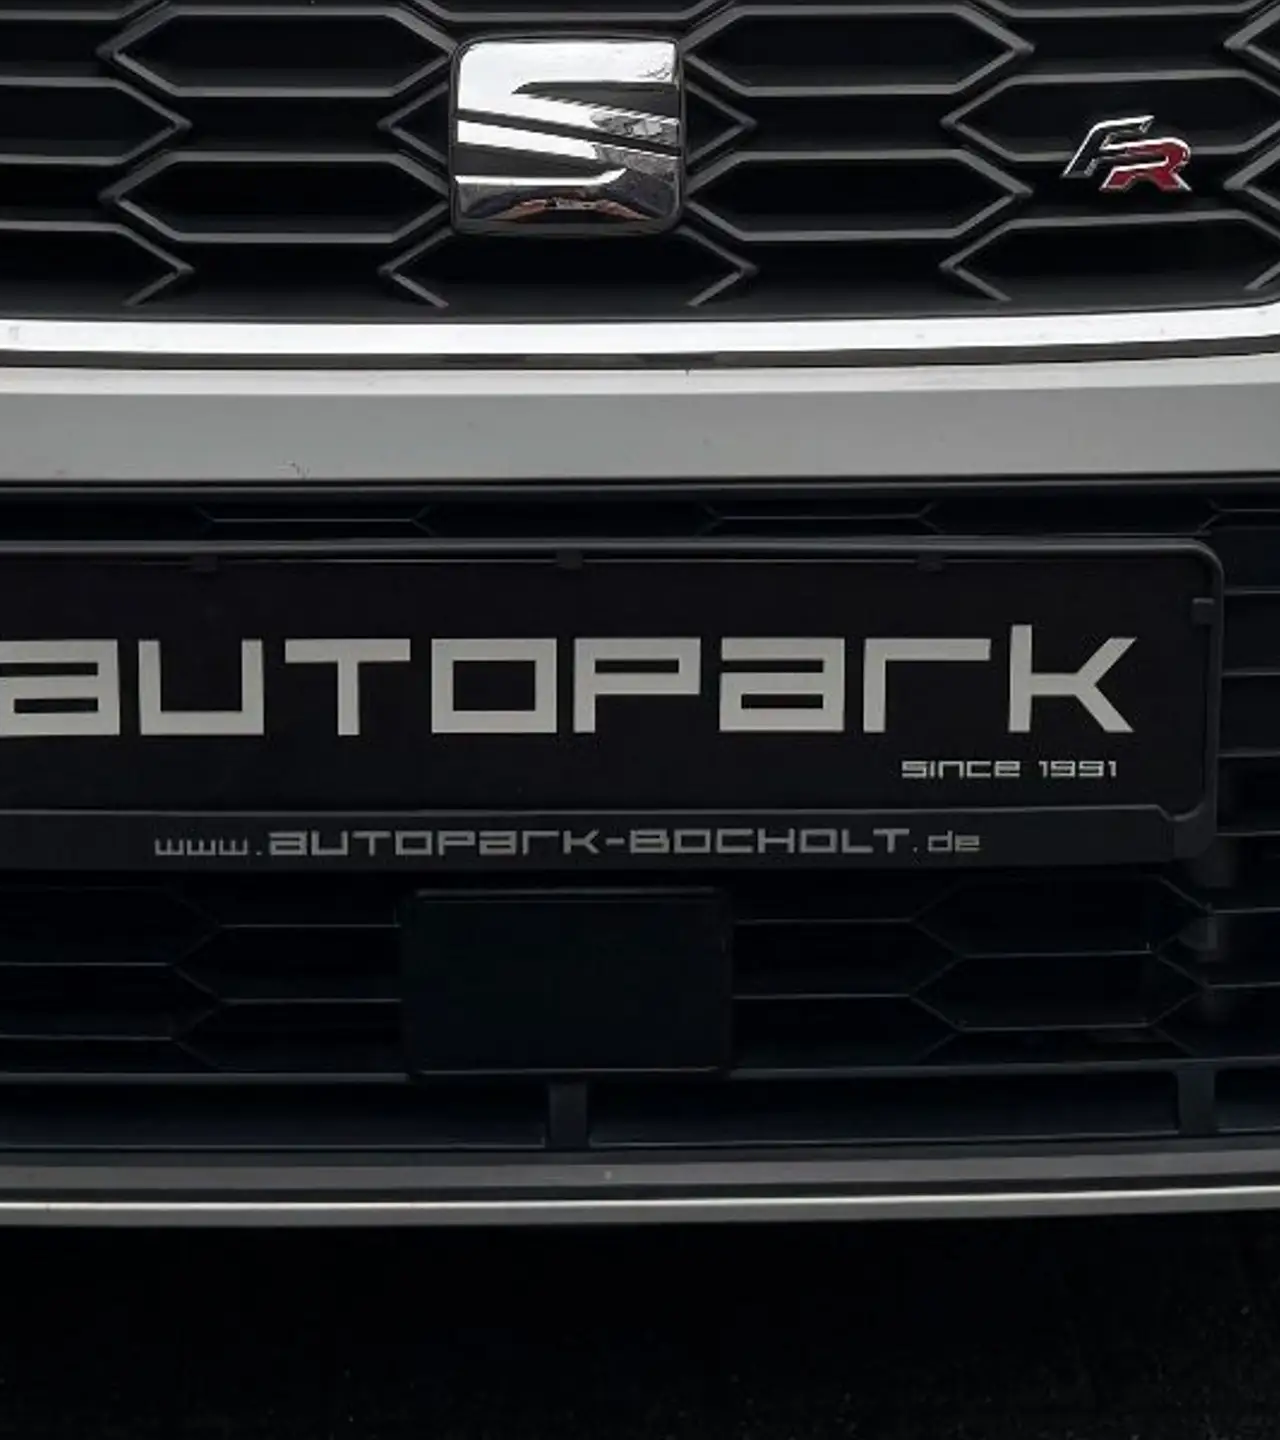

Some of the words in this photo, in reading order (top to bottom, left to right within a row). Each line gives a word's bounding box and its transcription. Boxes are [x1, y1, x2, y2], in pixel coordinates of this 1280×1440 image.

[1060, 114, 1192, 193] FR
[901, 759, 1021, 779] since
[1038, 759, 1117, 778] 1991
